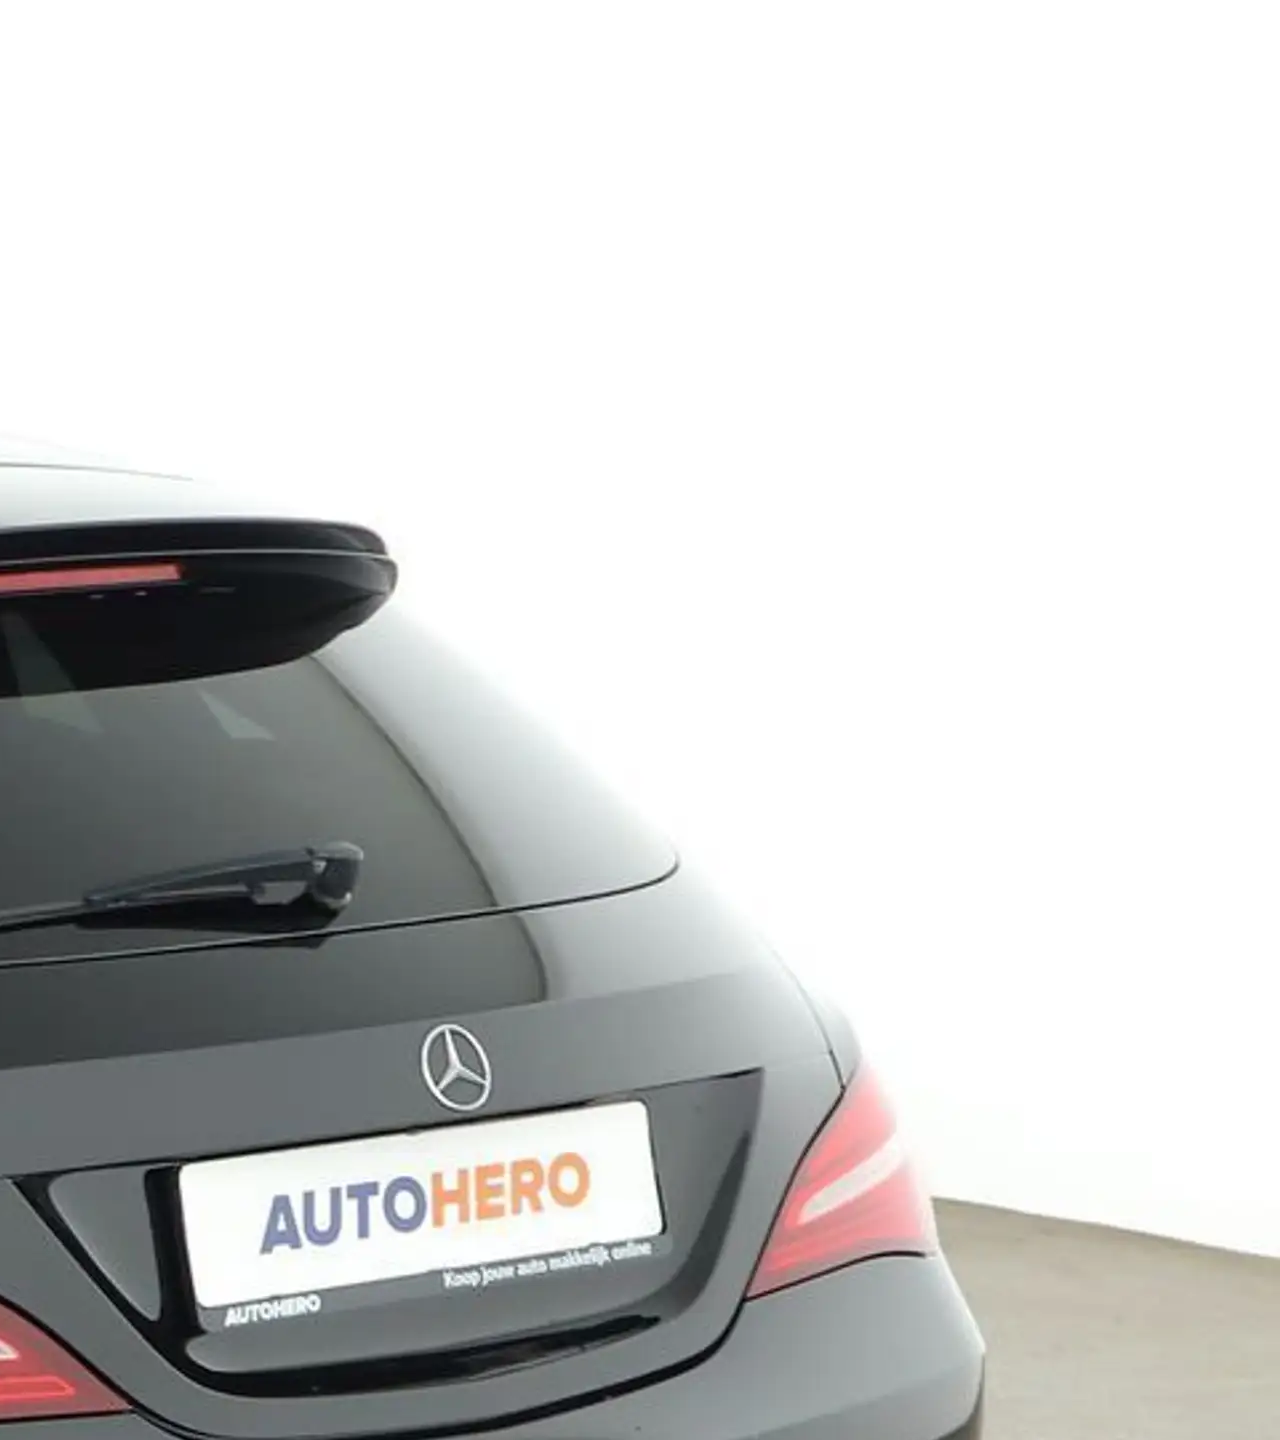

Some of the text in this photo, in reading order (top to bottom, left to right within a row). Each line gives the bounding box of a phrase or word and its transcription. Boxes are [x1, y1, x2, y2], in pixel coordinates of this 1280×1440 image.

[260, 1152, 591, 1255] AUTOHERO
[443, 1269, 481, 1289] Koop
[516, 1257, 548, 1277] auto
[548, 1246, 611, 1270] makkelijk
[610, 1241, 652, 1261] online
[224, 1293, 321, 1327] AUTOHERO
